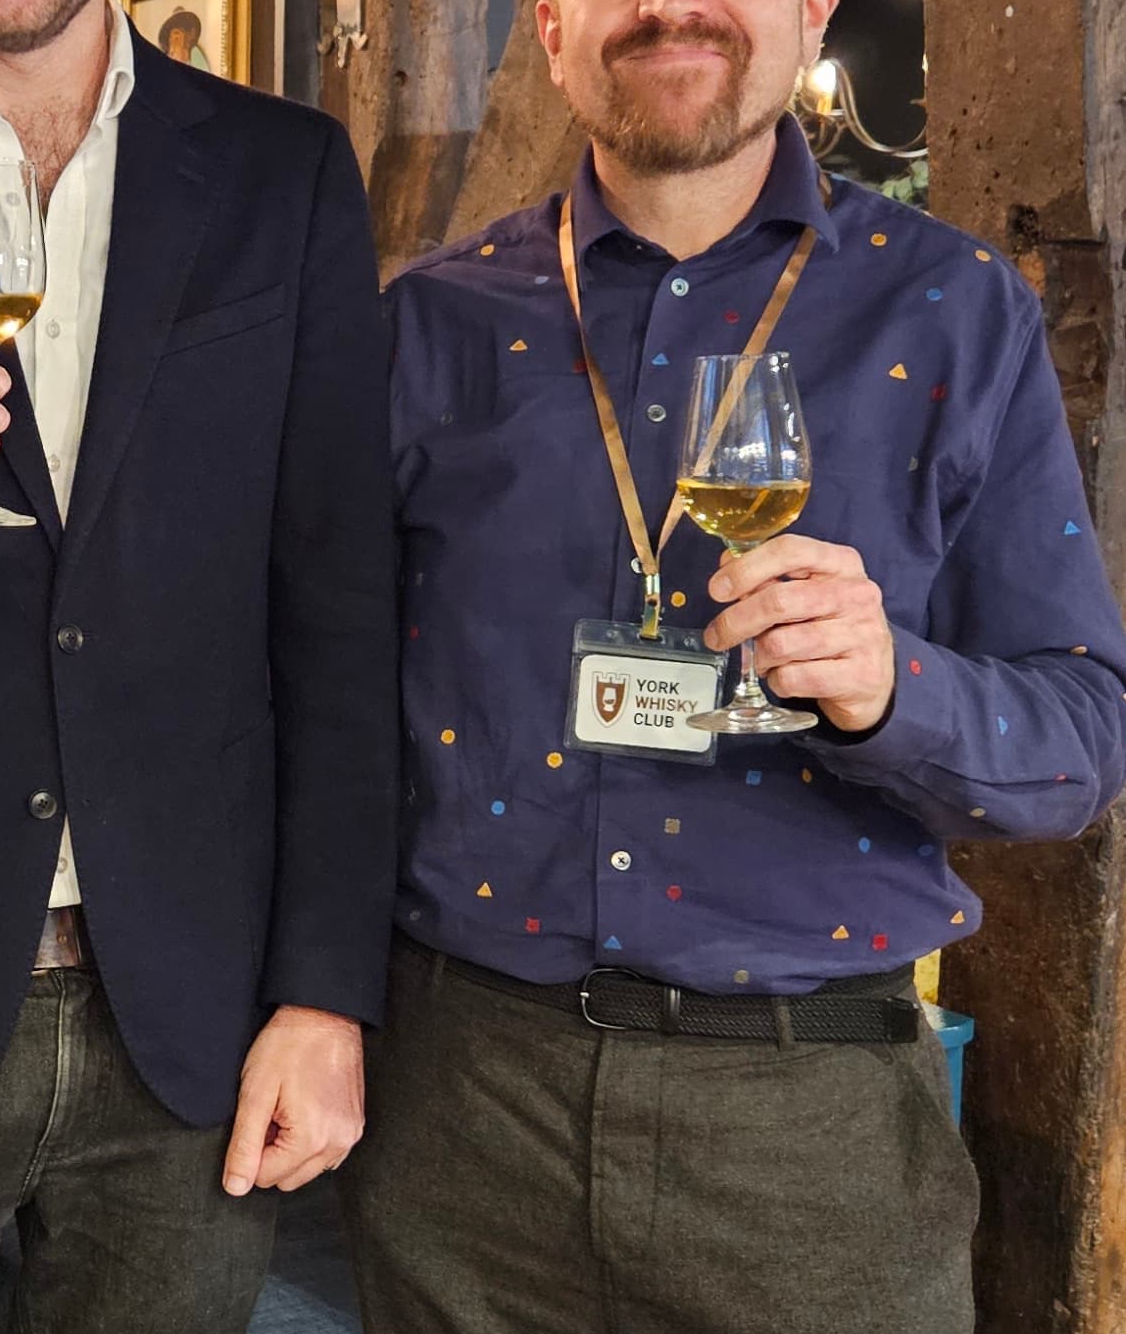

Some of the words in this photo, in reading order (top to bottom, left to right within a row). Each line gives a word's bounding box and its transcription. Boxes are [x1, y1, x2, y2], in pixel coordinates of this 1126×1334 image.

[636, 678, 680, 695] YORK
[635, 695, 699, 714] WHISKY
[633, 712, 675, 729] CLUB
